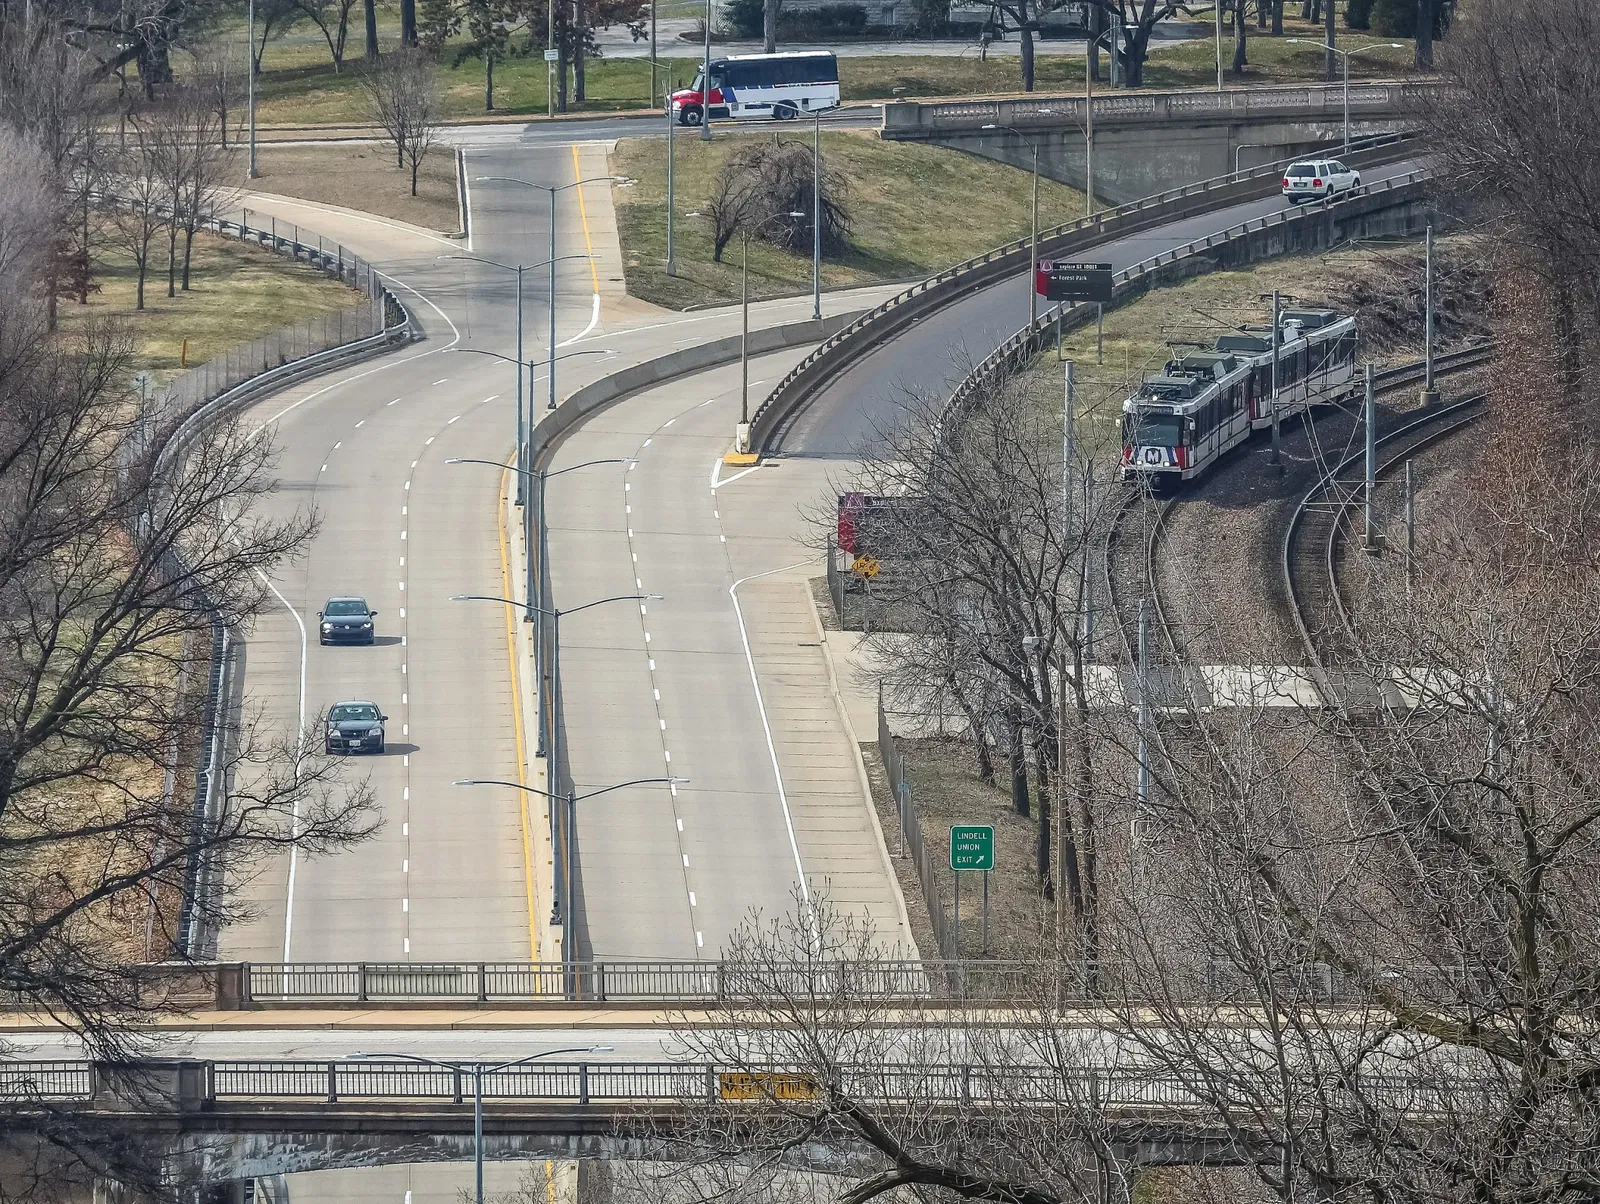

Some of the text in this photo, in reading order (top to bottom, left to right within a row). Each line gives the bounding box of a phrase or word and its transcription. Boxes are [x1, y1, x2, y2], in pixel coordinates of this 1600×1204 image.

[957, 832, 988, 840] LINDELL
[957, 843, 980, 851] UNION
[956, 855, 973, 863] EXIT
